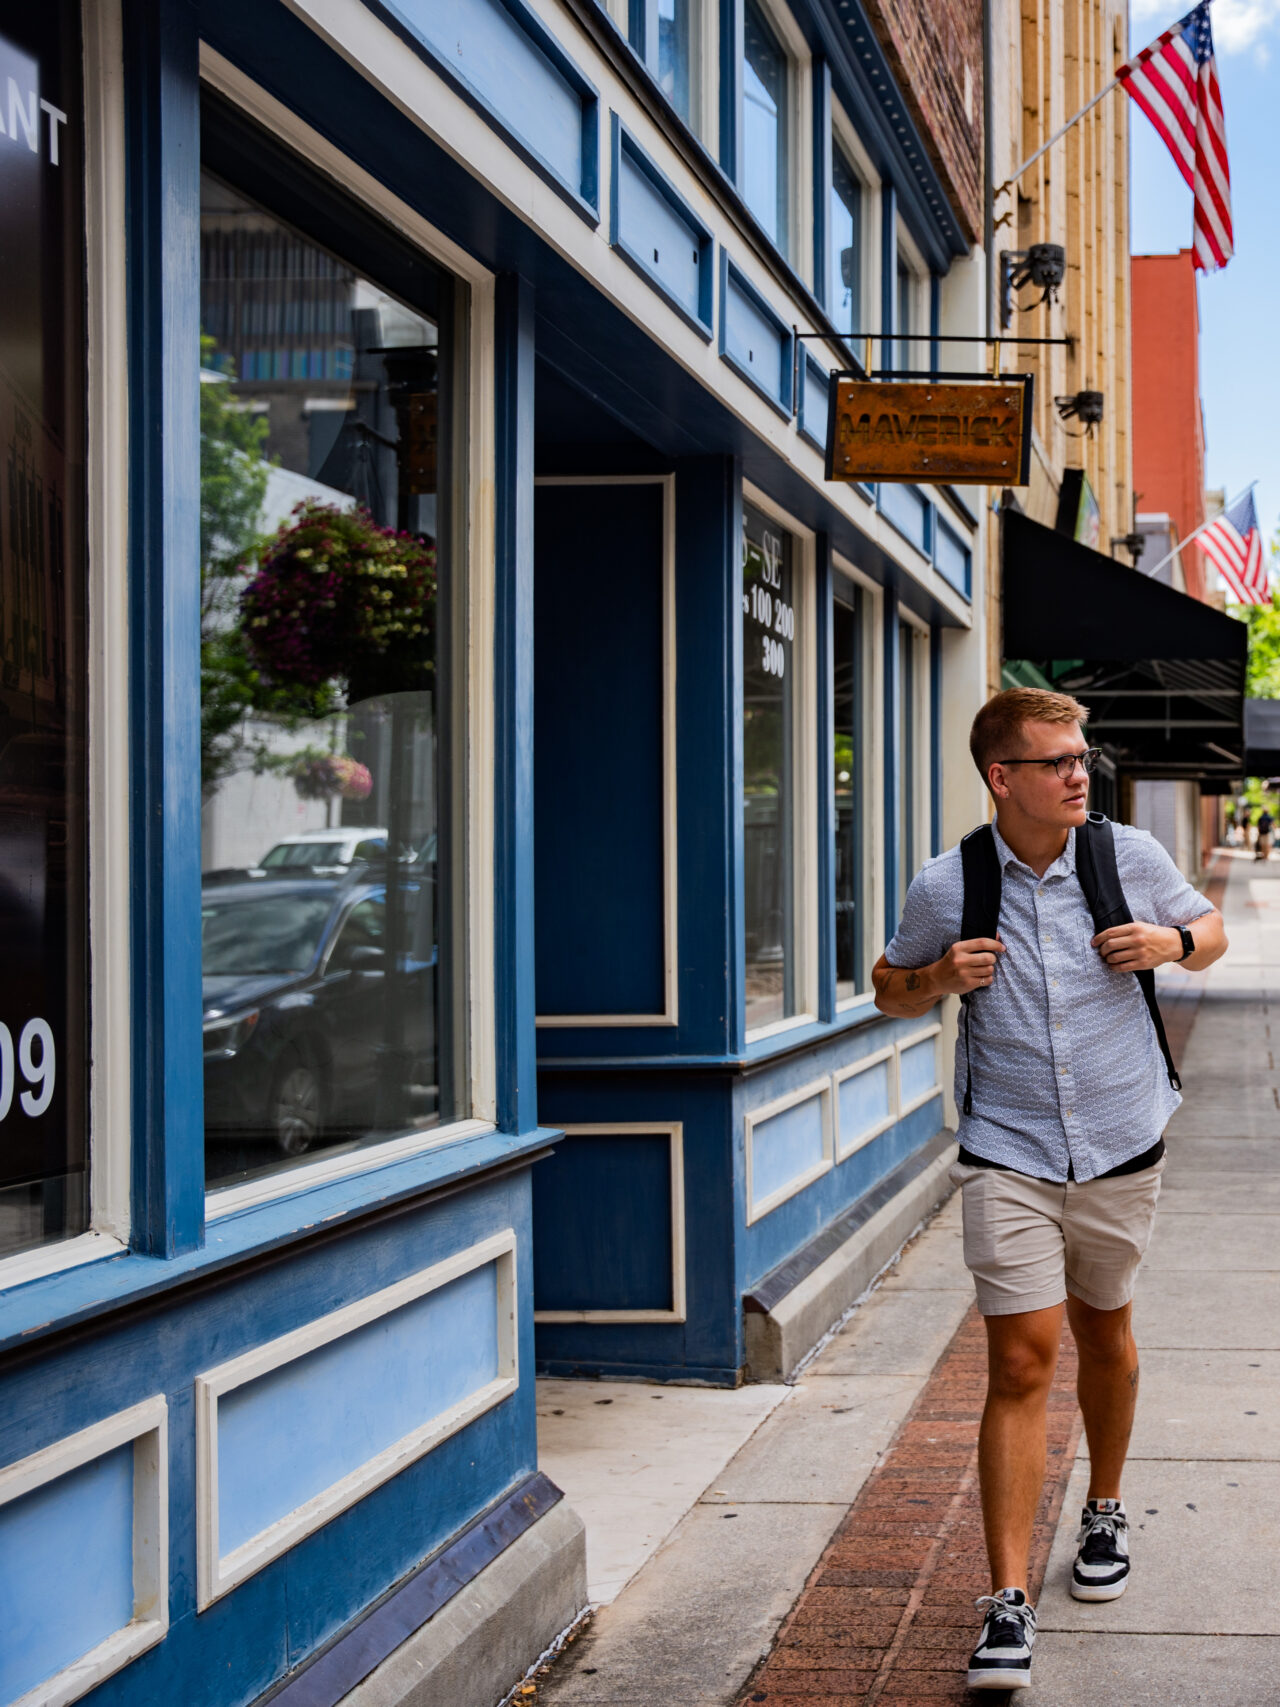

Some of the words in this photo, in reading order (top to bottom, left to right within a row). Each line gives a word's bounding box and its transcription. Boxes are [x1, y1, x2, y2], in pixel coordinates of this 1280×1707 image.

[0, 76, 68, 166] NT
[838, 413, 1015, 448] MAVERICK
[751, 584, 772, 628] 100
[775, 599, 795, 641] 200
[762, 634, 785, 678] 300
